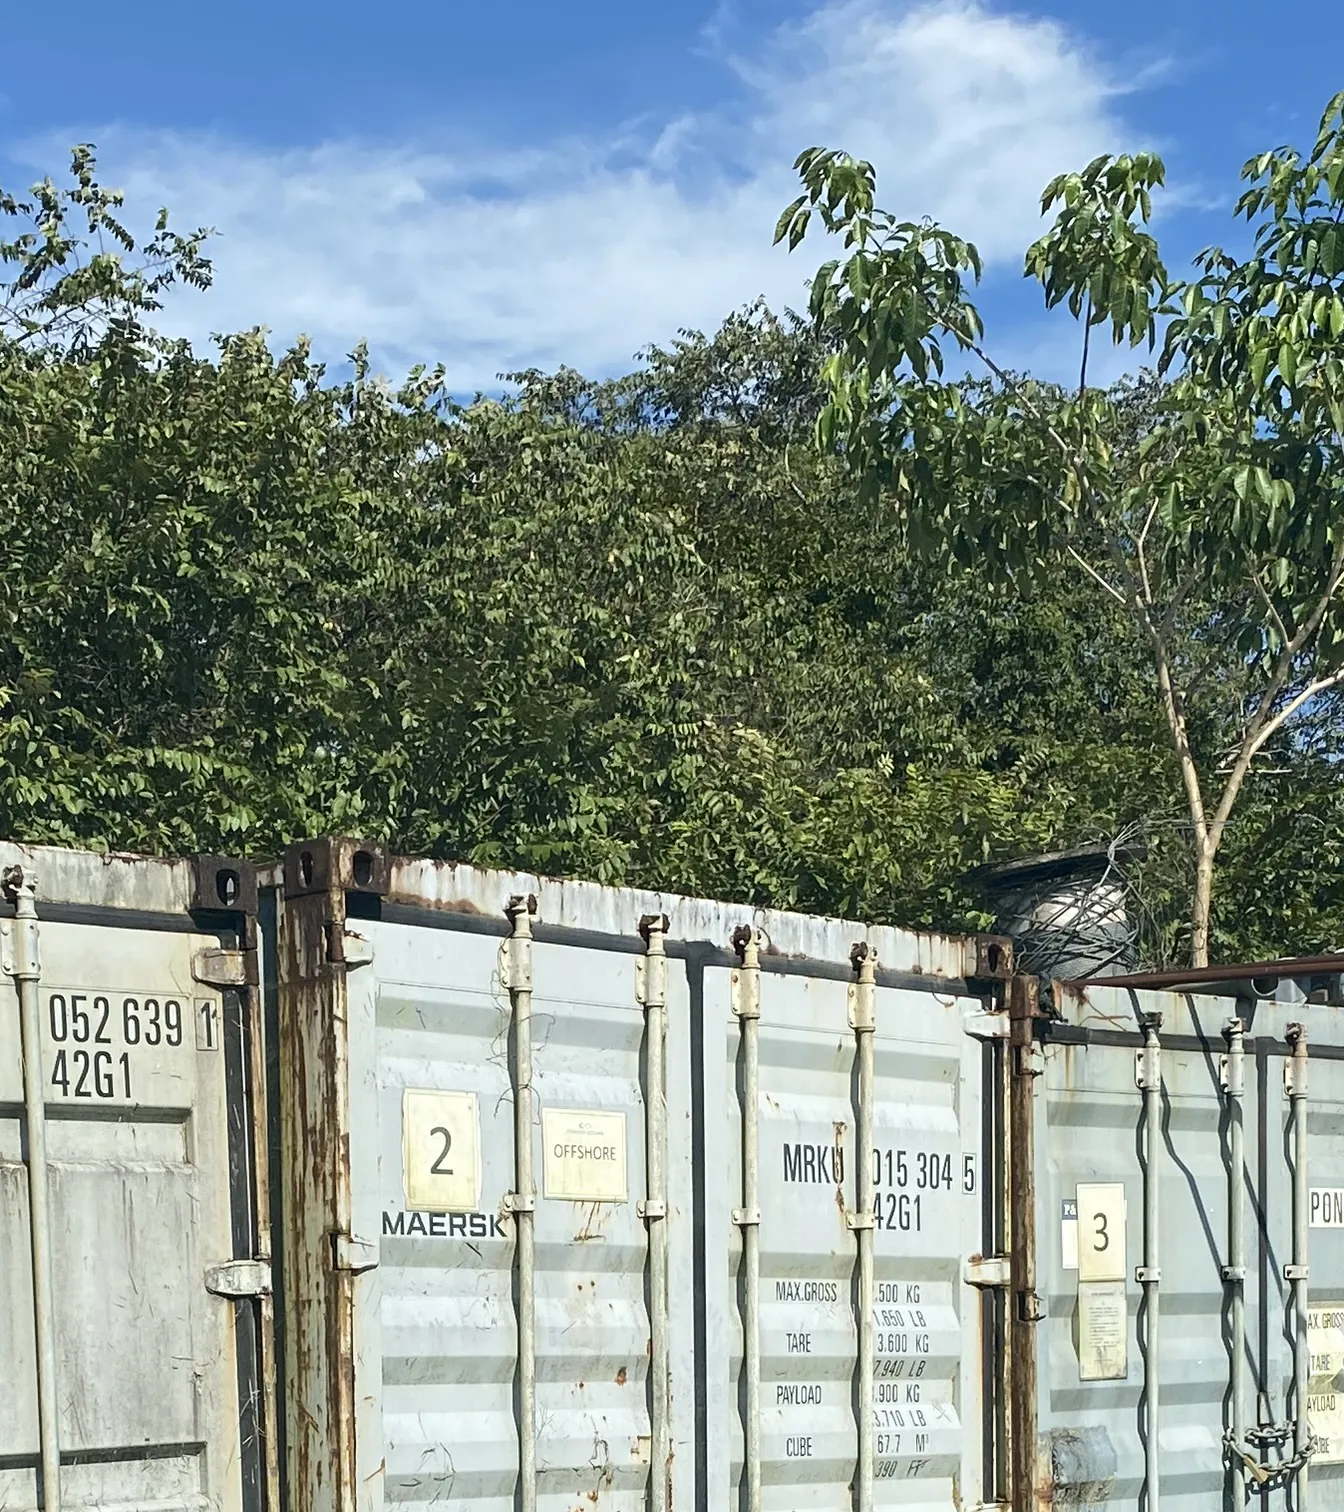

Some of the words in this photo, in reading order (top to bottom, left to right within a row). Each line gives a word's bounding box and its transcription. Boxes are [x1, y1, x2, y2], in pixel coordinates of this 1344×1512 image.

[50, 994, 112, 1044] 052
[122, 998, 183, 1047] 639
[199, 1002, 218, 1048] 1
[51, 1049, 132, 1099] 42G1
[430, 1126, 454, 1175] 2
[554, 1143, 616, 1161] OFFSHORE
[783, 1143, 844, 1185] MRKU
[916, 1152, 953, 1190] 304
[964, 1155, 974, 1192] 5
[381, 1210, 507, 1238] MAERSK
[1093, 1212, 1110, 1252] 3
[776, 1281, 837, 1302] MAX.GROSS
[874, 1283, 898, 1303] .500
[906, 1285, 920, 1304] KG
[873, 1310, 905, 1327] 1.650
[908, 1310, 926, 1327] LB
[786, 1333, 811, 1353] TARE
[877, 1333, 907, 1353] 3.600
[915, 1334, 929, 1353] KG
[908, 1361, 926, 1377] LB
[1311, 1354, 1330, 1372] TARE
[777, 1385, 822, 1405] PAYLOAD
[873, 1384, 898, 1403] .900
[906, 1384, 920, 1403] KG
[1307, 1395, 1336, 1411] AYLOAD
[873, 1410, 905, 1427] 3.710
[908, 1410, 926, 1427] LB
[786, 1437, 812, 1457] CUBE
[877, 1434, 901, 1454] 67.7
